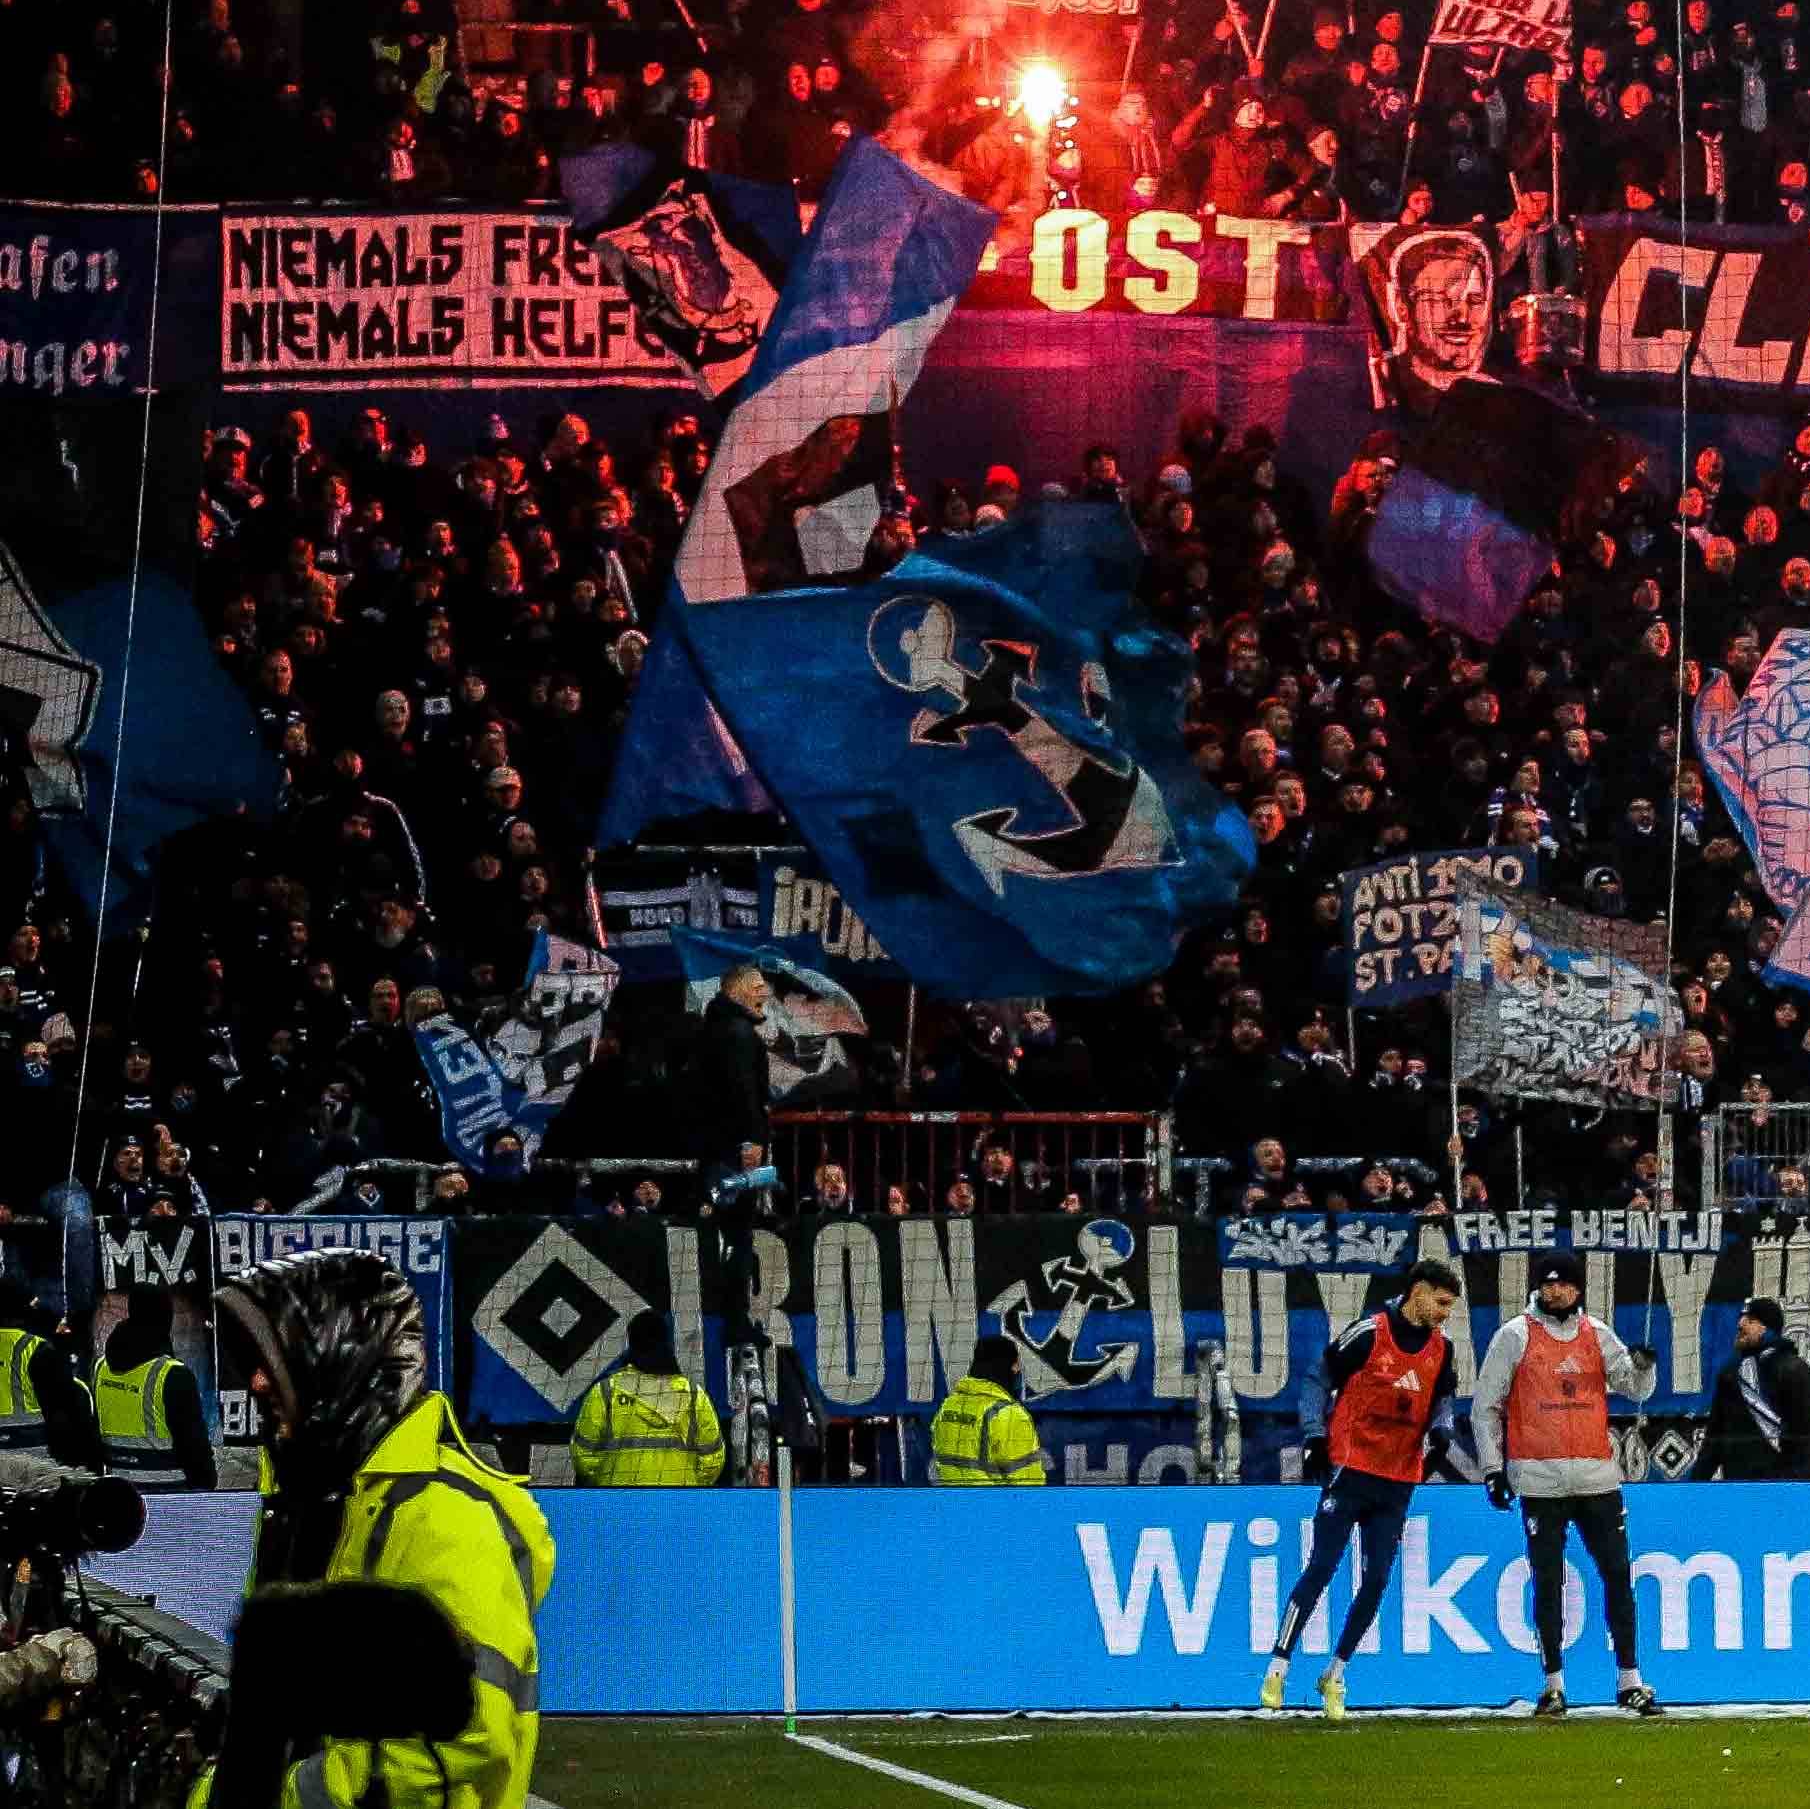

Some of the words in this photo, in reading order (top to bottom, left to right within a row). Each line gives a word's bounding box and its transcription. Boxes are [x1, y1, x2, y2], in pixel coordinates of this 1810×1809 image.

[231, 227, 464, 289] NIEMALS
[492, 225, 622, 289] FRE
[1029, 207, 1312, 321] OST
[231, 300, 464, 361] NIEMALS
[0, 339, 131, 390] nger
[101, 1226, 197, 1289] M.V.
[1453, 1211, 1557, 1253] FREE
[1571, 1209, 1722, 1252] BENTJI
